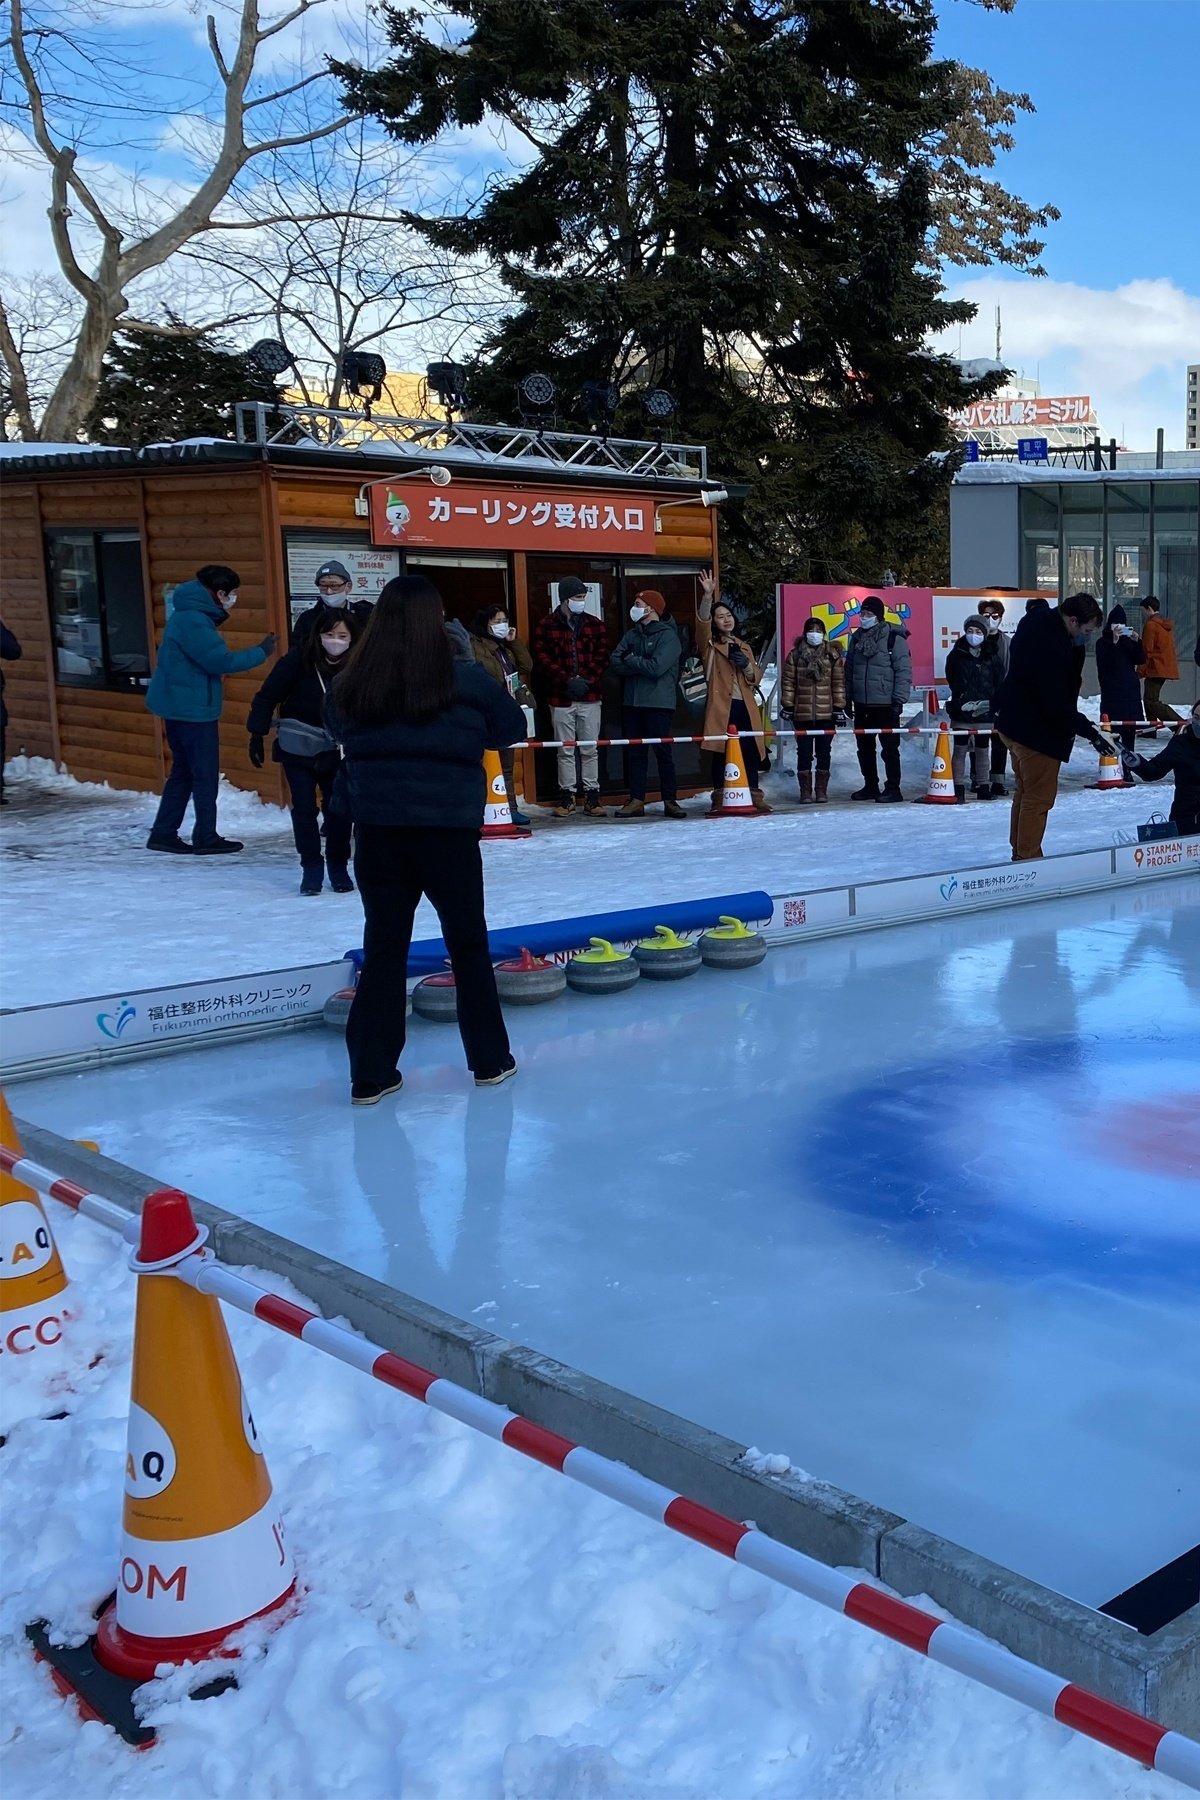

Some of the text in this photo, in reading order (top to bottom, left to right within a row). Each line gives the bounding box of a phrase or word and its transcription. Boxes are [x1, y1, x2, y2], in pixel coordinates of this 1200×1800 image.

[428, 496, 644, 531] カーリング受付入口
[1146, 842, 1183, 856] STARMAN
[1146, 854, 1182, 867] PROJECT
[962, 871, 1037, 891] 福住整形外科クリニック
[147, 984, 312, 1021] 福住整形外科クリニック
[152, 1000, 309, 1033] Fukuzumi orthopedic clinic
